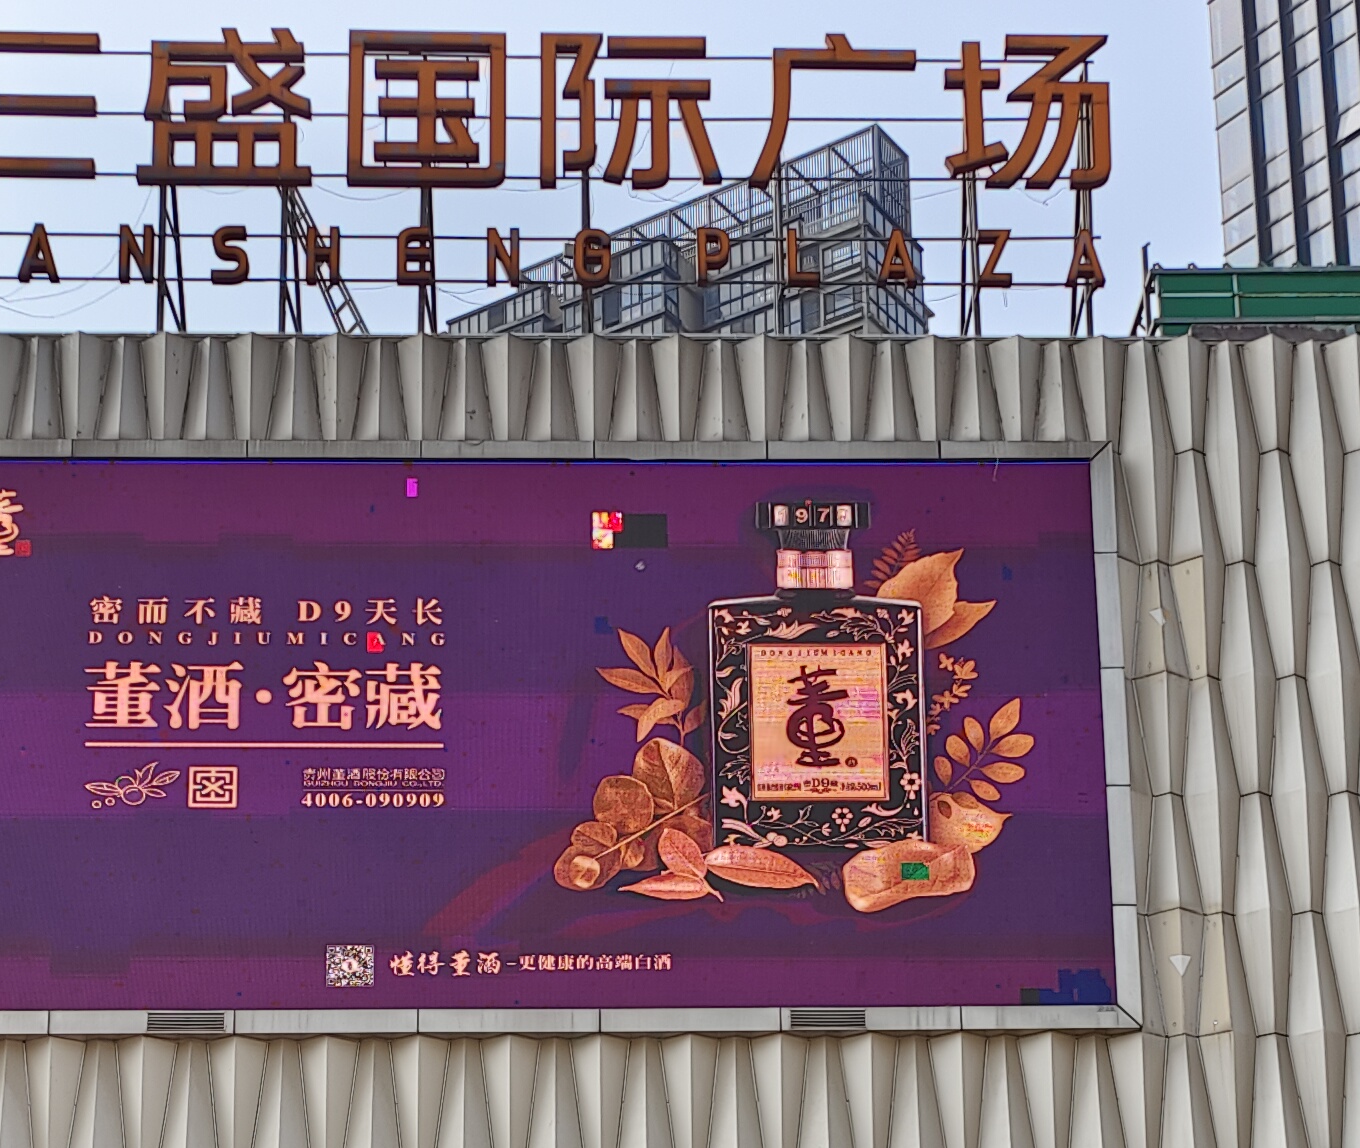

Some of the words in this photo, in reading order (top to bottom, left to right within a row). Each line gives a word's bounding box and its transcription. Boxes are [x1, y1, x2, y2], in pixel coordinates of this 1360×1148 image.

[696, 228, 1107, 288] PLAZA
[90, 596, 263, 625] 密而不藏
[297, 597, 443, 625] D9天长
[88, 631, 445, 647] DONGJIUMICANG
[84, 660, 442, 730] 董酒·密藏
[303, 767, 446, 781] 贵州董酒股份有限公司
[301, 792, 445, 808] 4006-090909
